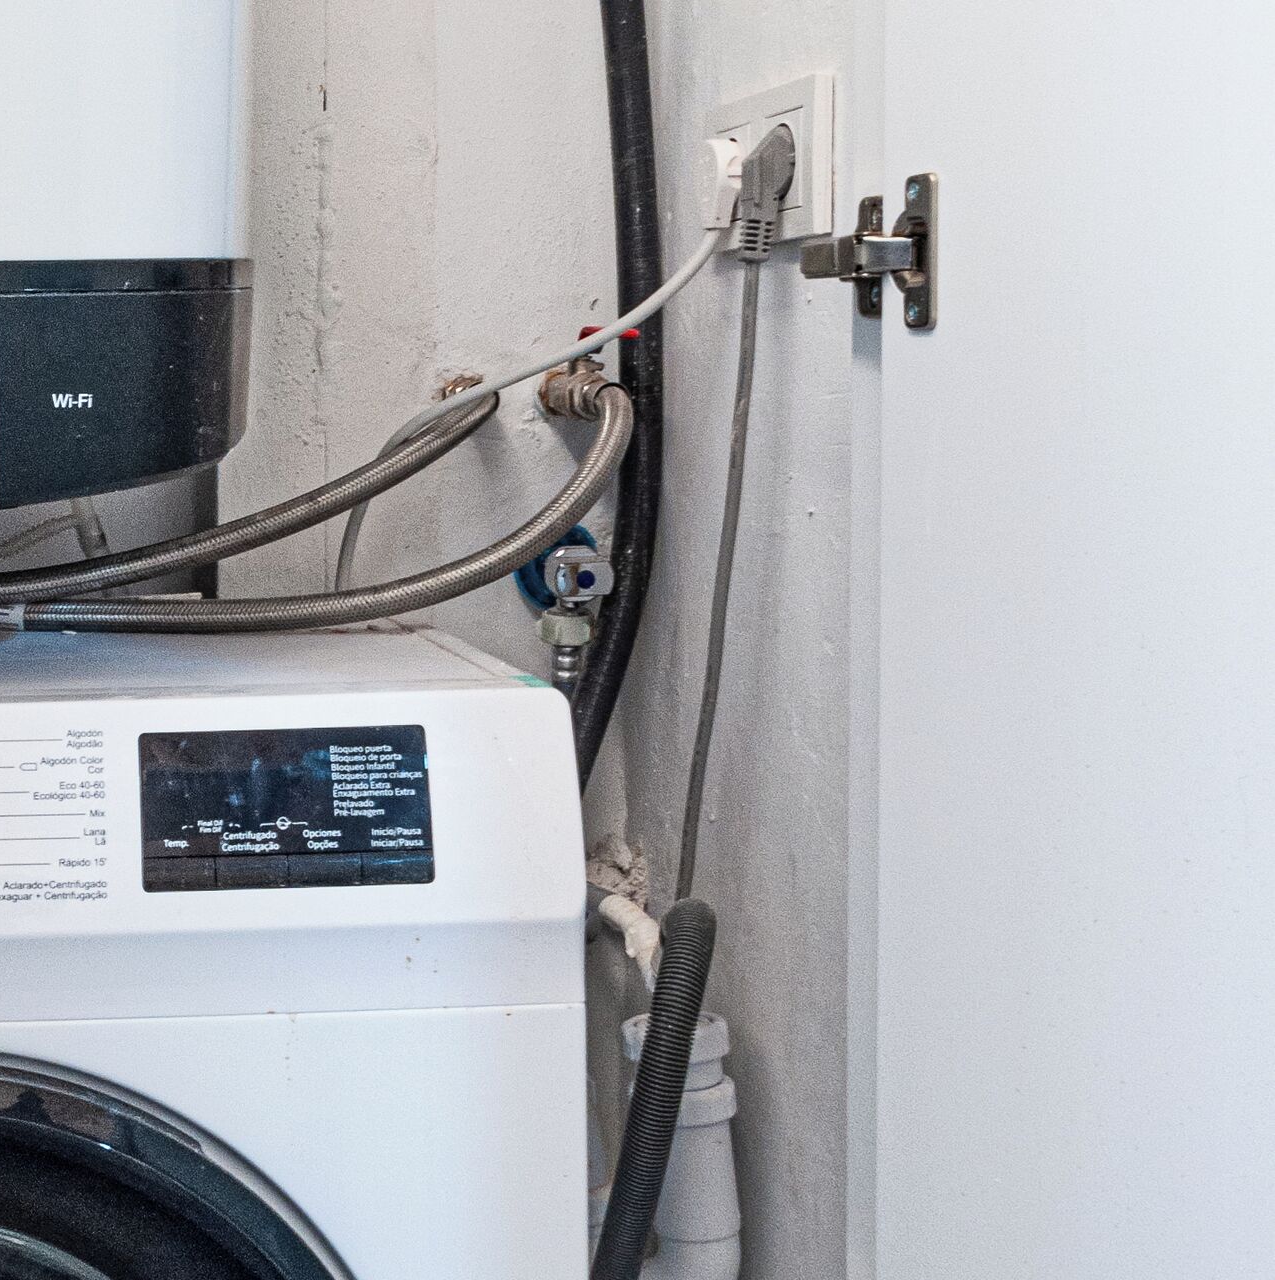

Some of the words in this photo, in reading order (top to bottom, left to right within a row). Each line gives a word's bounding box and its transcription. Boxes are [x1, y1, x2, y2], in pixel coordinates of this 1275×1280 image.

[52, 393, 93, 409] Wi-Fi
[329, 745, 364, 754] Bloqueo
[365, 745, 392, 753] puerta
[79, 756, 104, 764] Color
[379, 753, 402, 762] porta
[87, 766, 104, 774] Cor
[330, 763, 365, 772] Bloqueo
[369, 772, 387, 781] para
[79, 781, 105, 789] 40-60
[333, 782, 369, 790] Aclarado
[370, 781, 391, 789] Extra
[79, 791, 105, 799] 40-60
[394, 788, 416, 796] Extra
[90, 809, 105, 817] Mix
[223, 830, 277, 842] Centrifugado
[302, 829, 342, 839] Opciones
[163, 839, 190, 849] Temp.
[221, 841, 280, 852] Centrifugação
[307, 840, 339, 850] Opções
